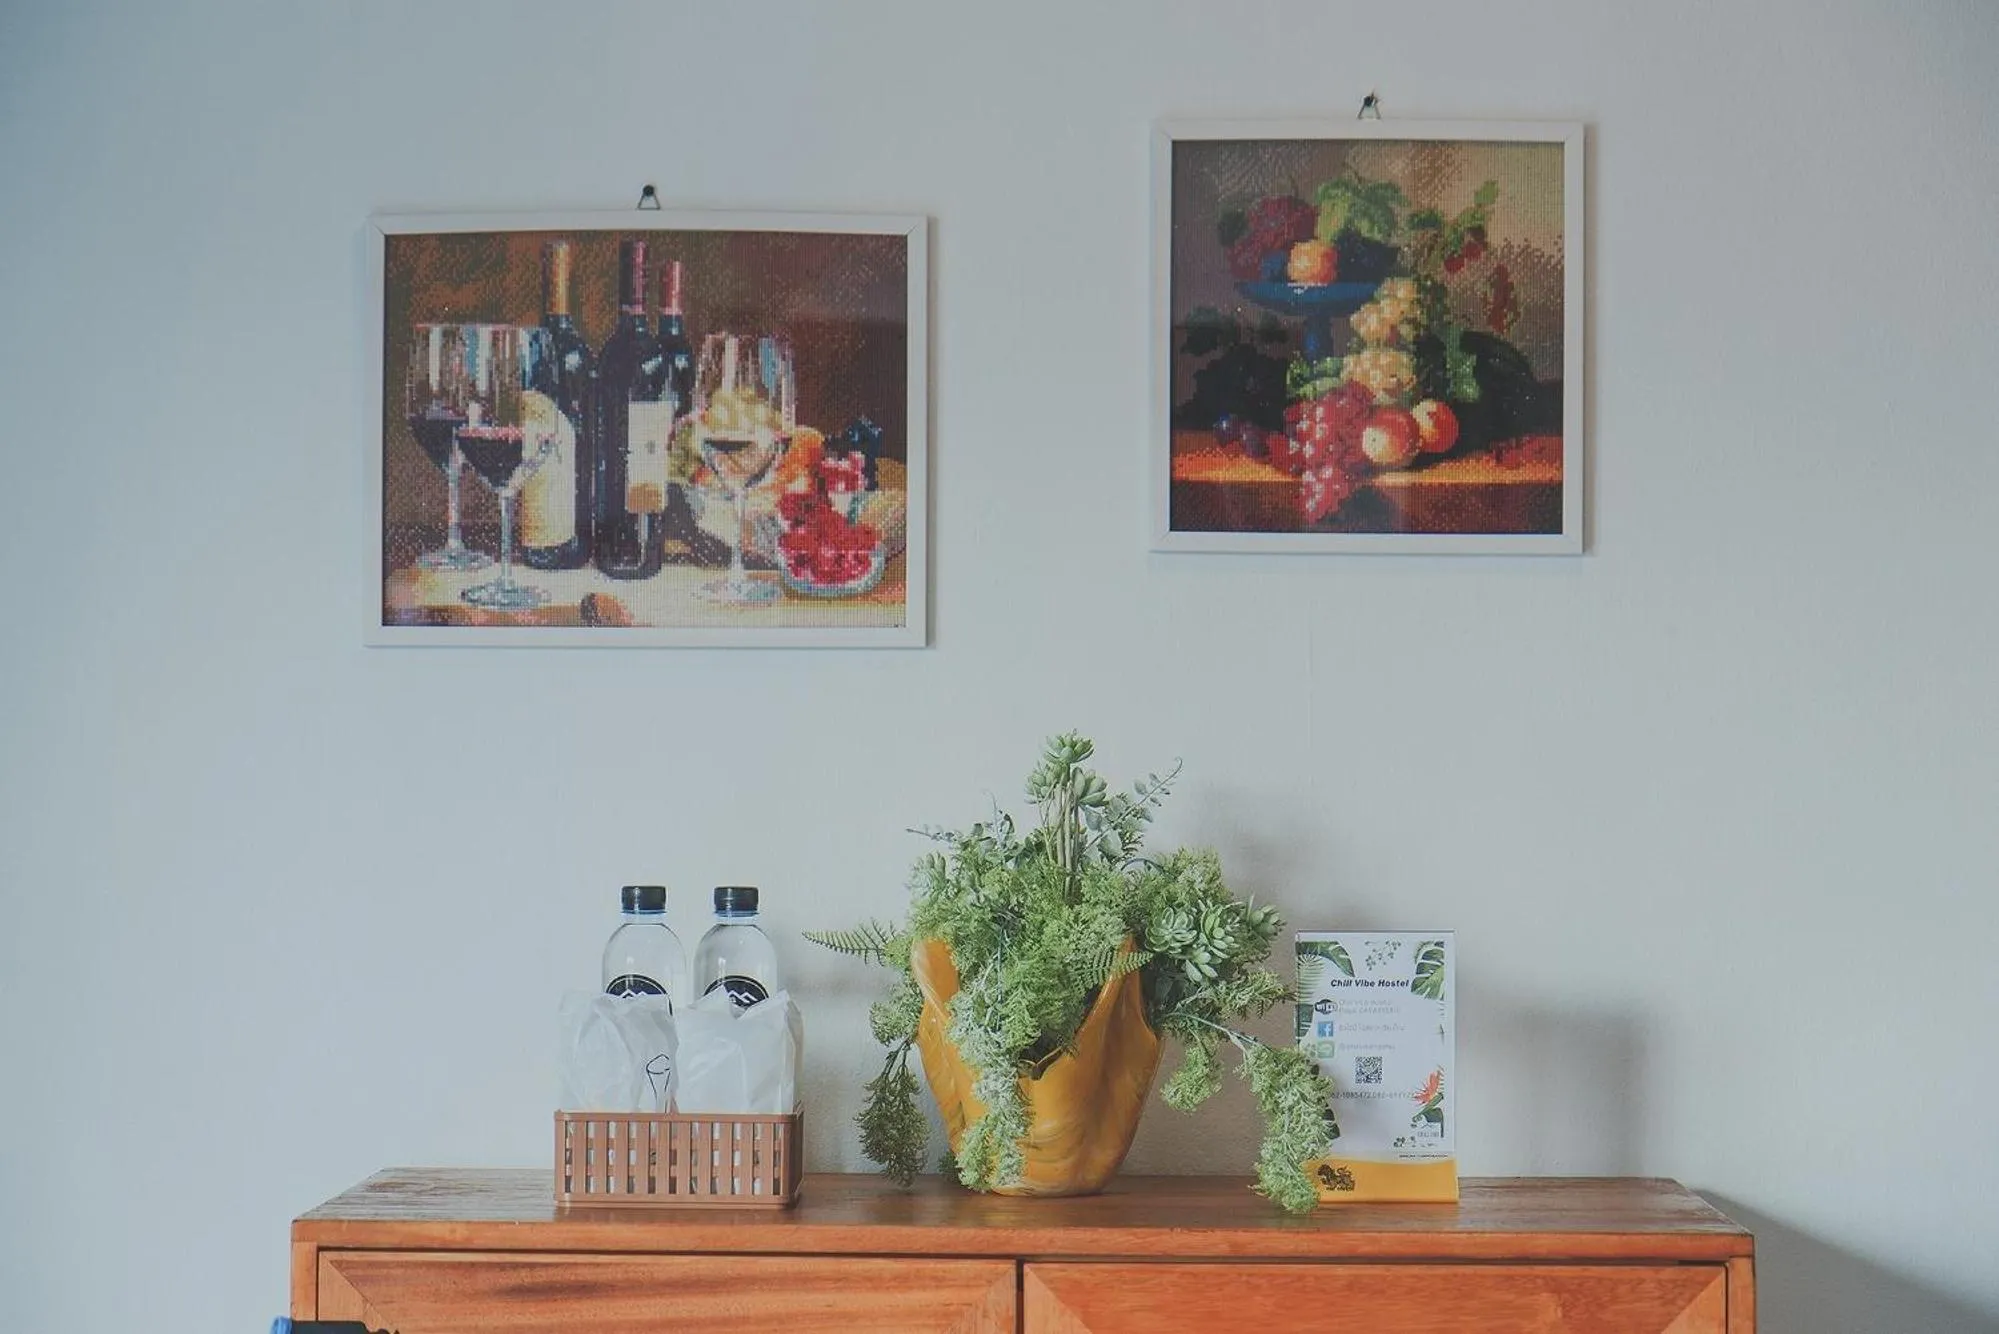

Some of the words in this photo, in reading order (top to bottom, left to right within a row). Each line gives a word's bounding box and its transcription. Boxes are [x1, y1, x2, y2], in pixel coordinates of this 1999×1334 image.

[1330, 979, 1352, 988] Chill
[1354, 979, 1375, 988] Vibe
[1377, 979, 1410, 988] Hostel
